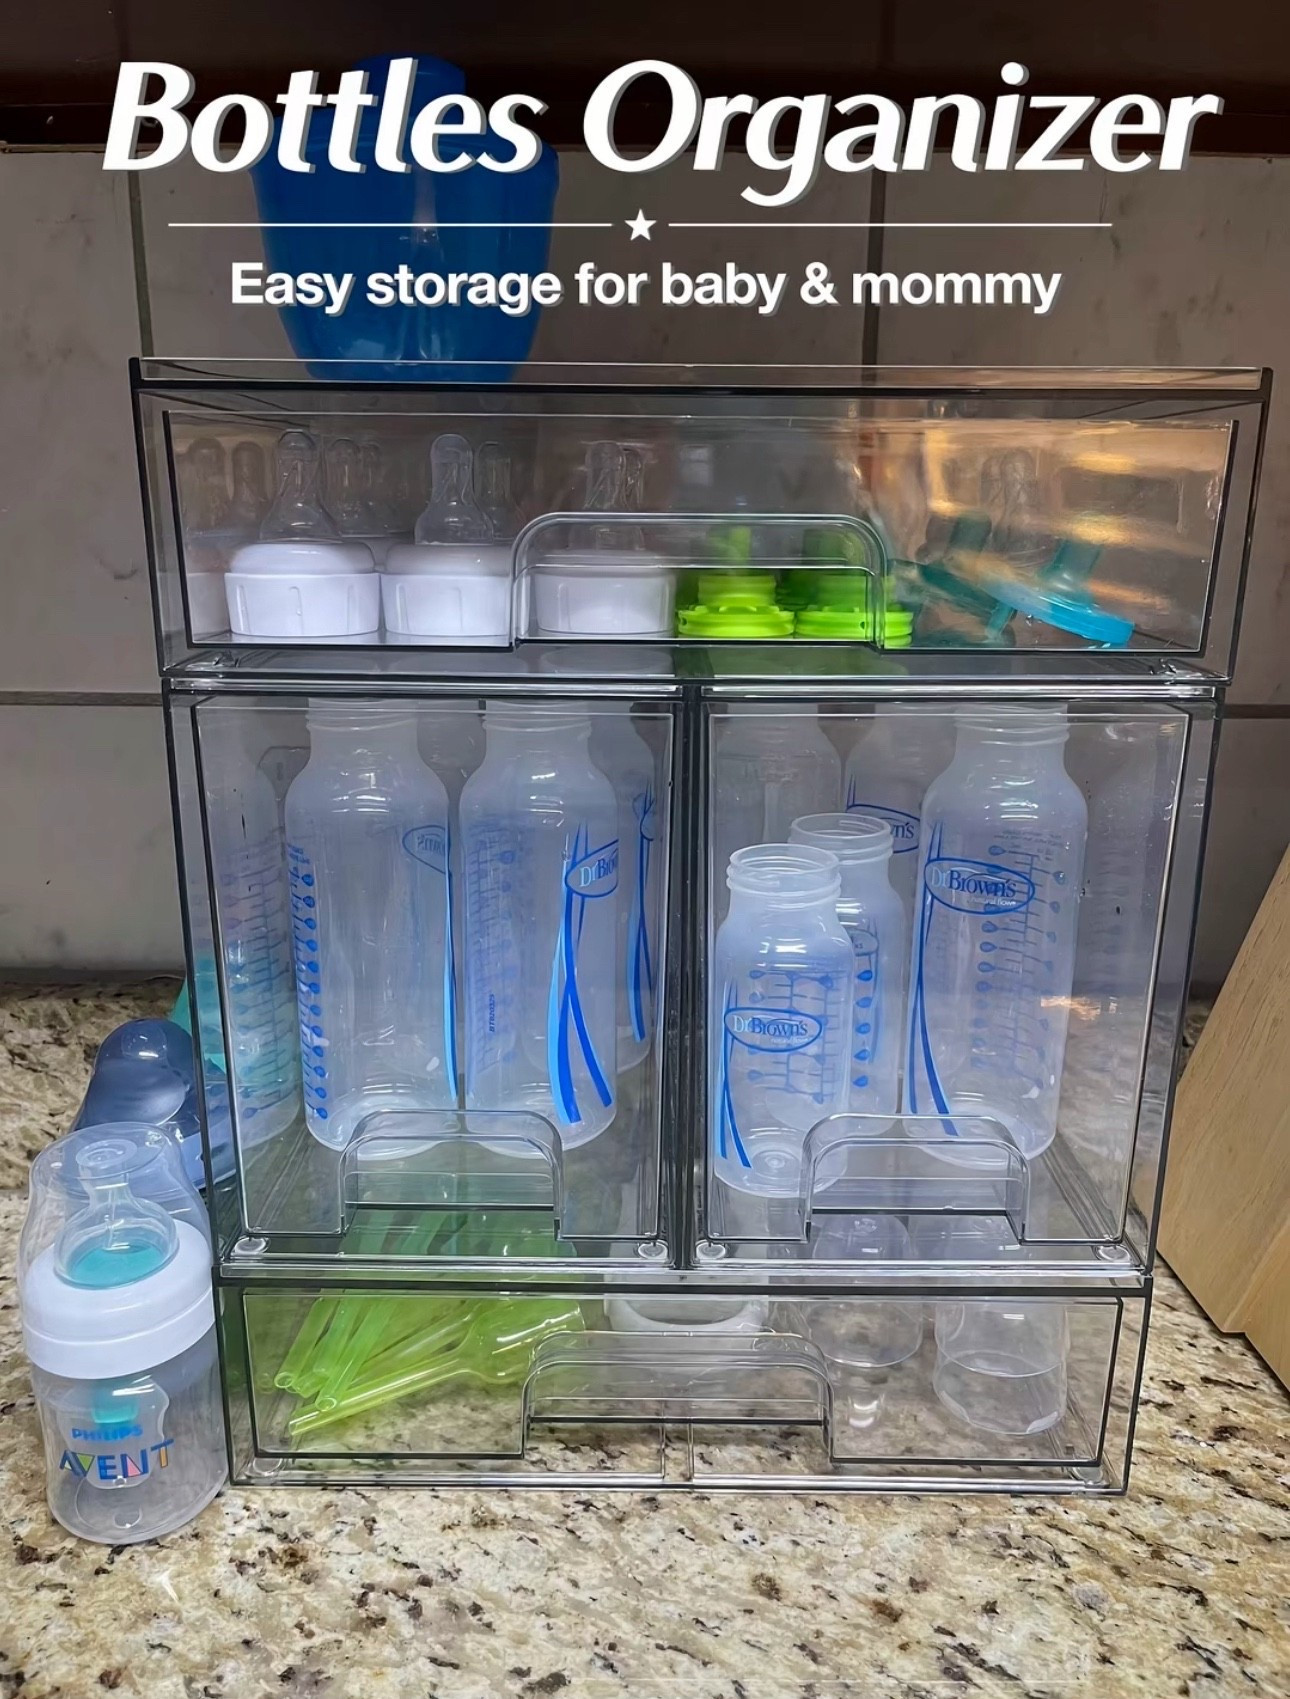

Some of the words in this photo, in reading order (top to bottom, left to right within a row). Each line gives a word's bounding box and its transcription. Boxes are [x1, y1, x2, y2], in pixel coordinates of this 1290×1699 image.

[948, 869, 1017, 898] Brown's
[751, 1017, 809, 1037] Brown's
[72, 1424, 143, 1442] PHILIPS
[59, 1438, 175, 1481] AVENT
